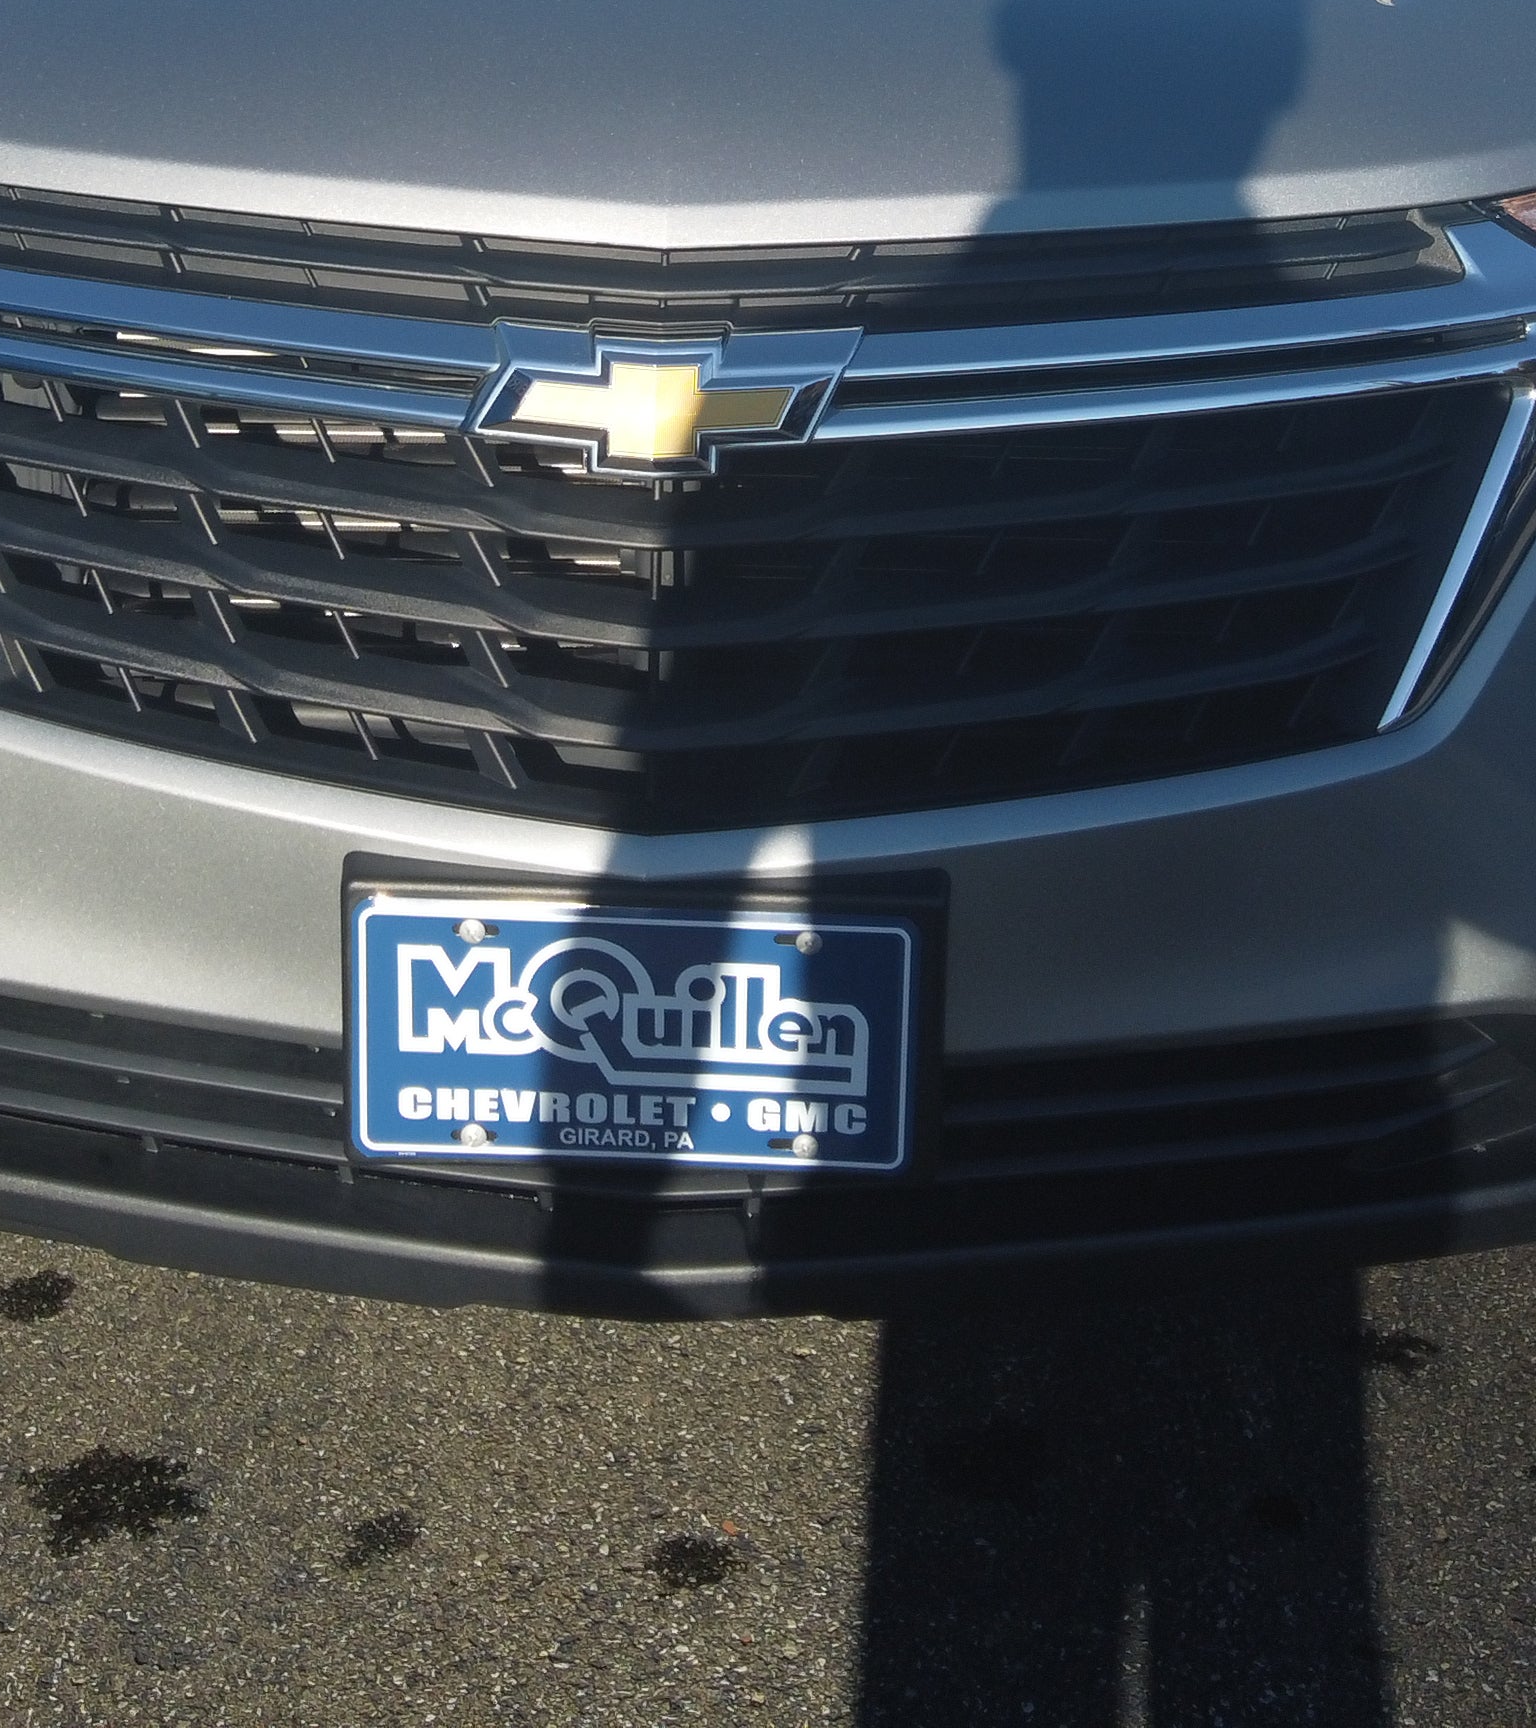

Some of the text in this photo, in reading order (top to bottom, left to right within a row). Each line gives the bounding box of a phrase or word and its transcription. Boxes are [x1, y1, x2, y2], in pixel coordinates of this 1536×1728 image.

[396, 936, 869, 1097] McQuillen
[397, 1086, 868, 1136] CHEVROLET GMC
[559, 1126, 695, 1152] GIRARD, PA
